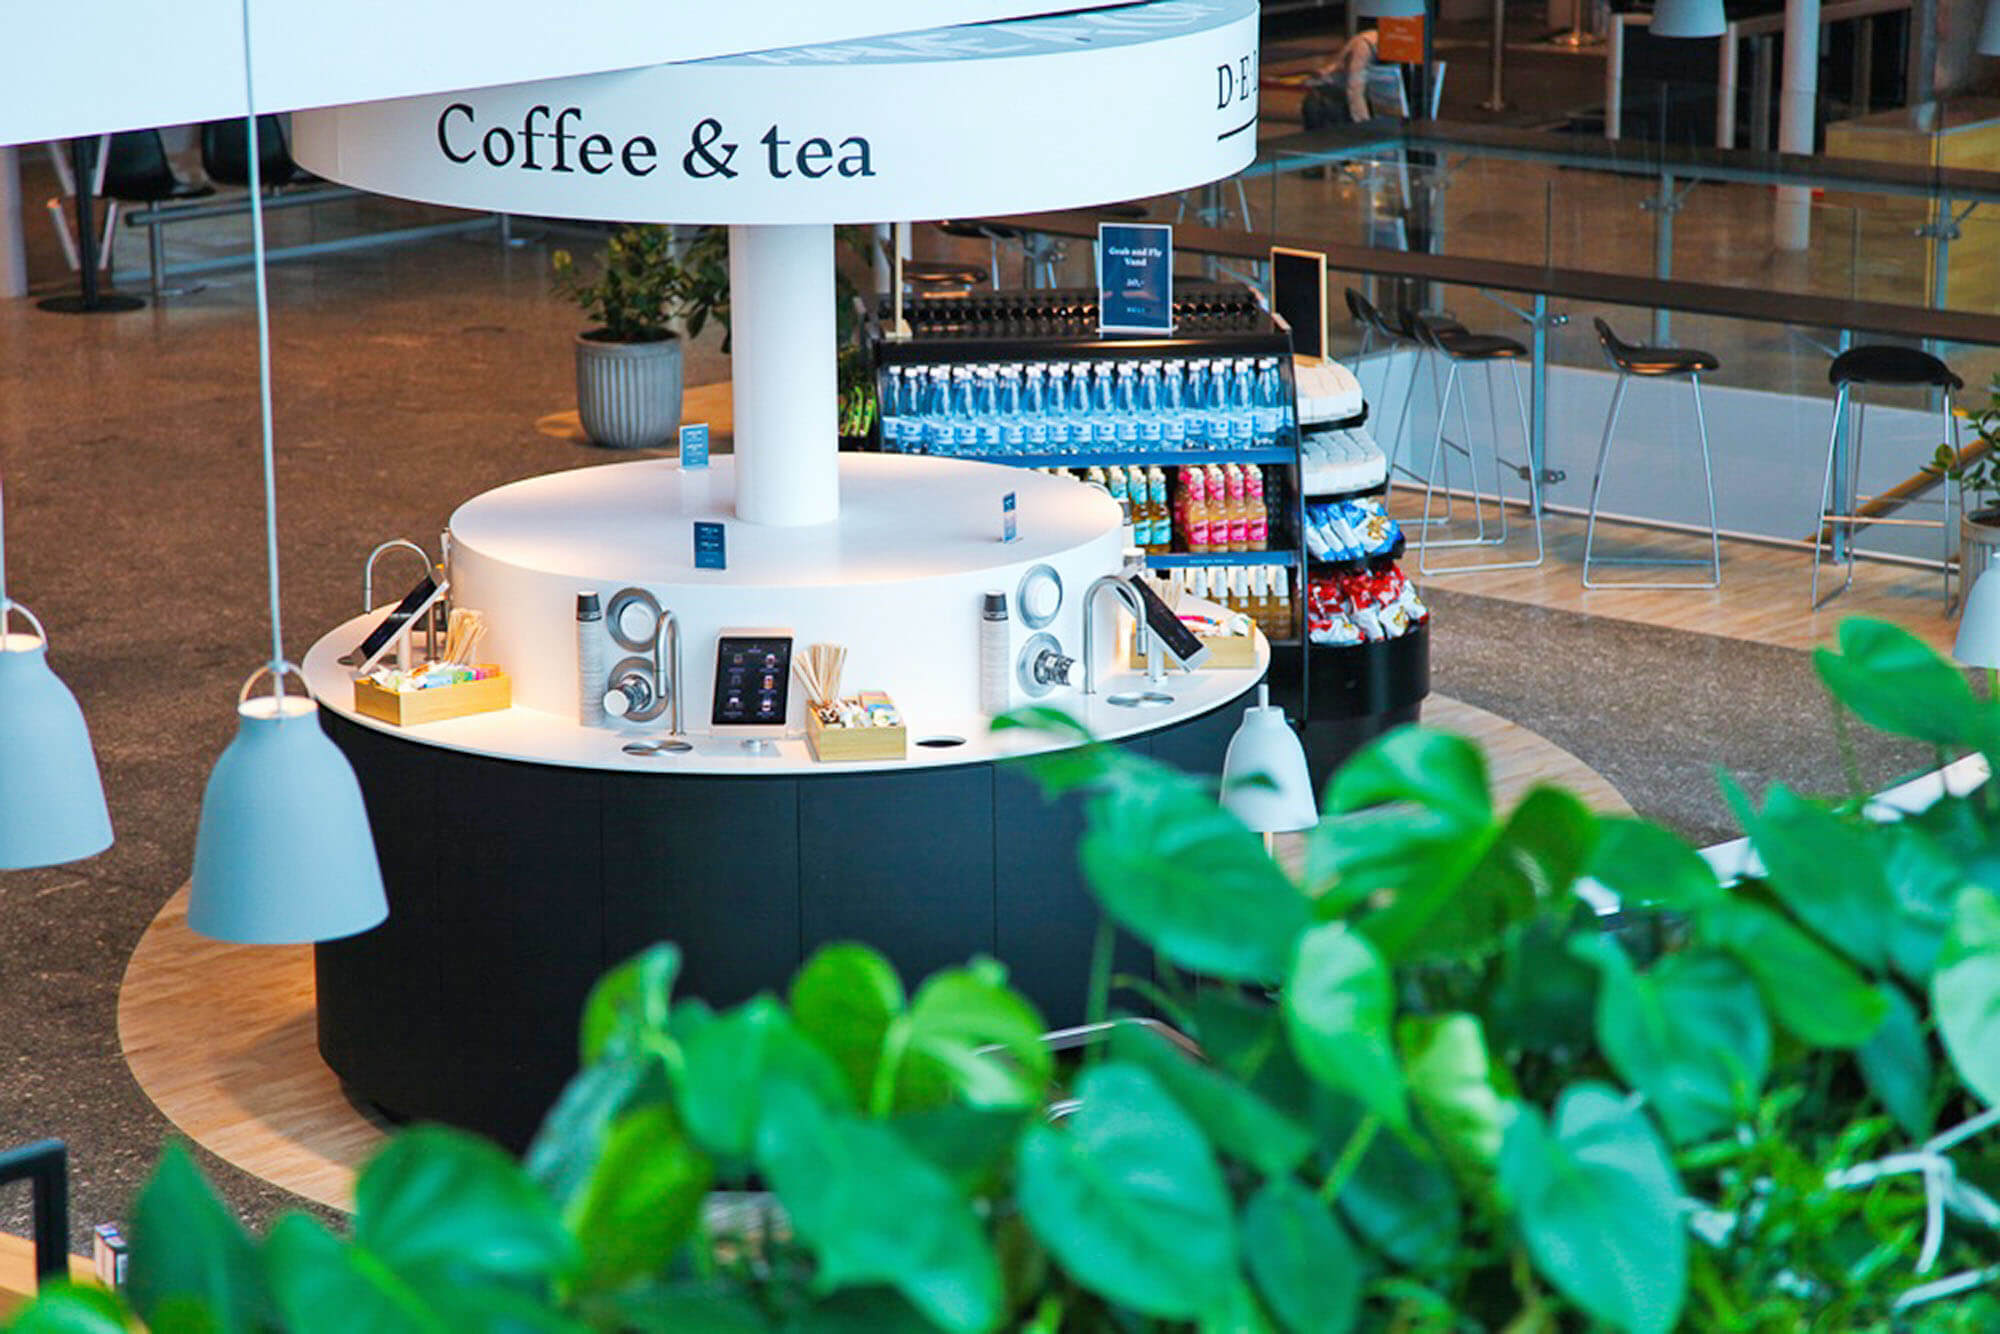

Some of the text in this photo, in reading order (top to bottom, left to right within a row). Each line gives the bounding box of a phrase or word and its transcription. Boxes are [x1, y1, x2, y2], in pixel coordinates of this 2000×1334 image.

[437, 102, 876, 179] Coffee & tea
